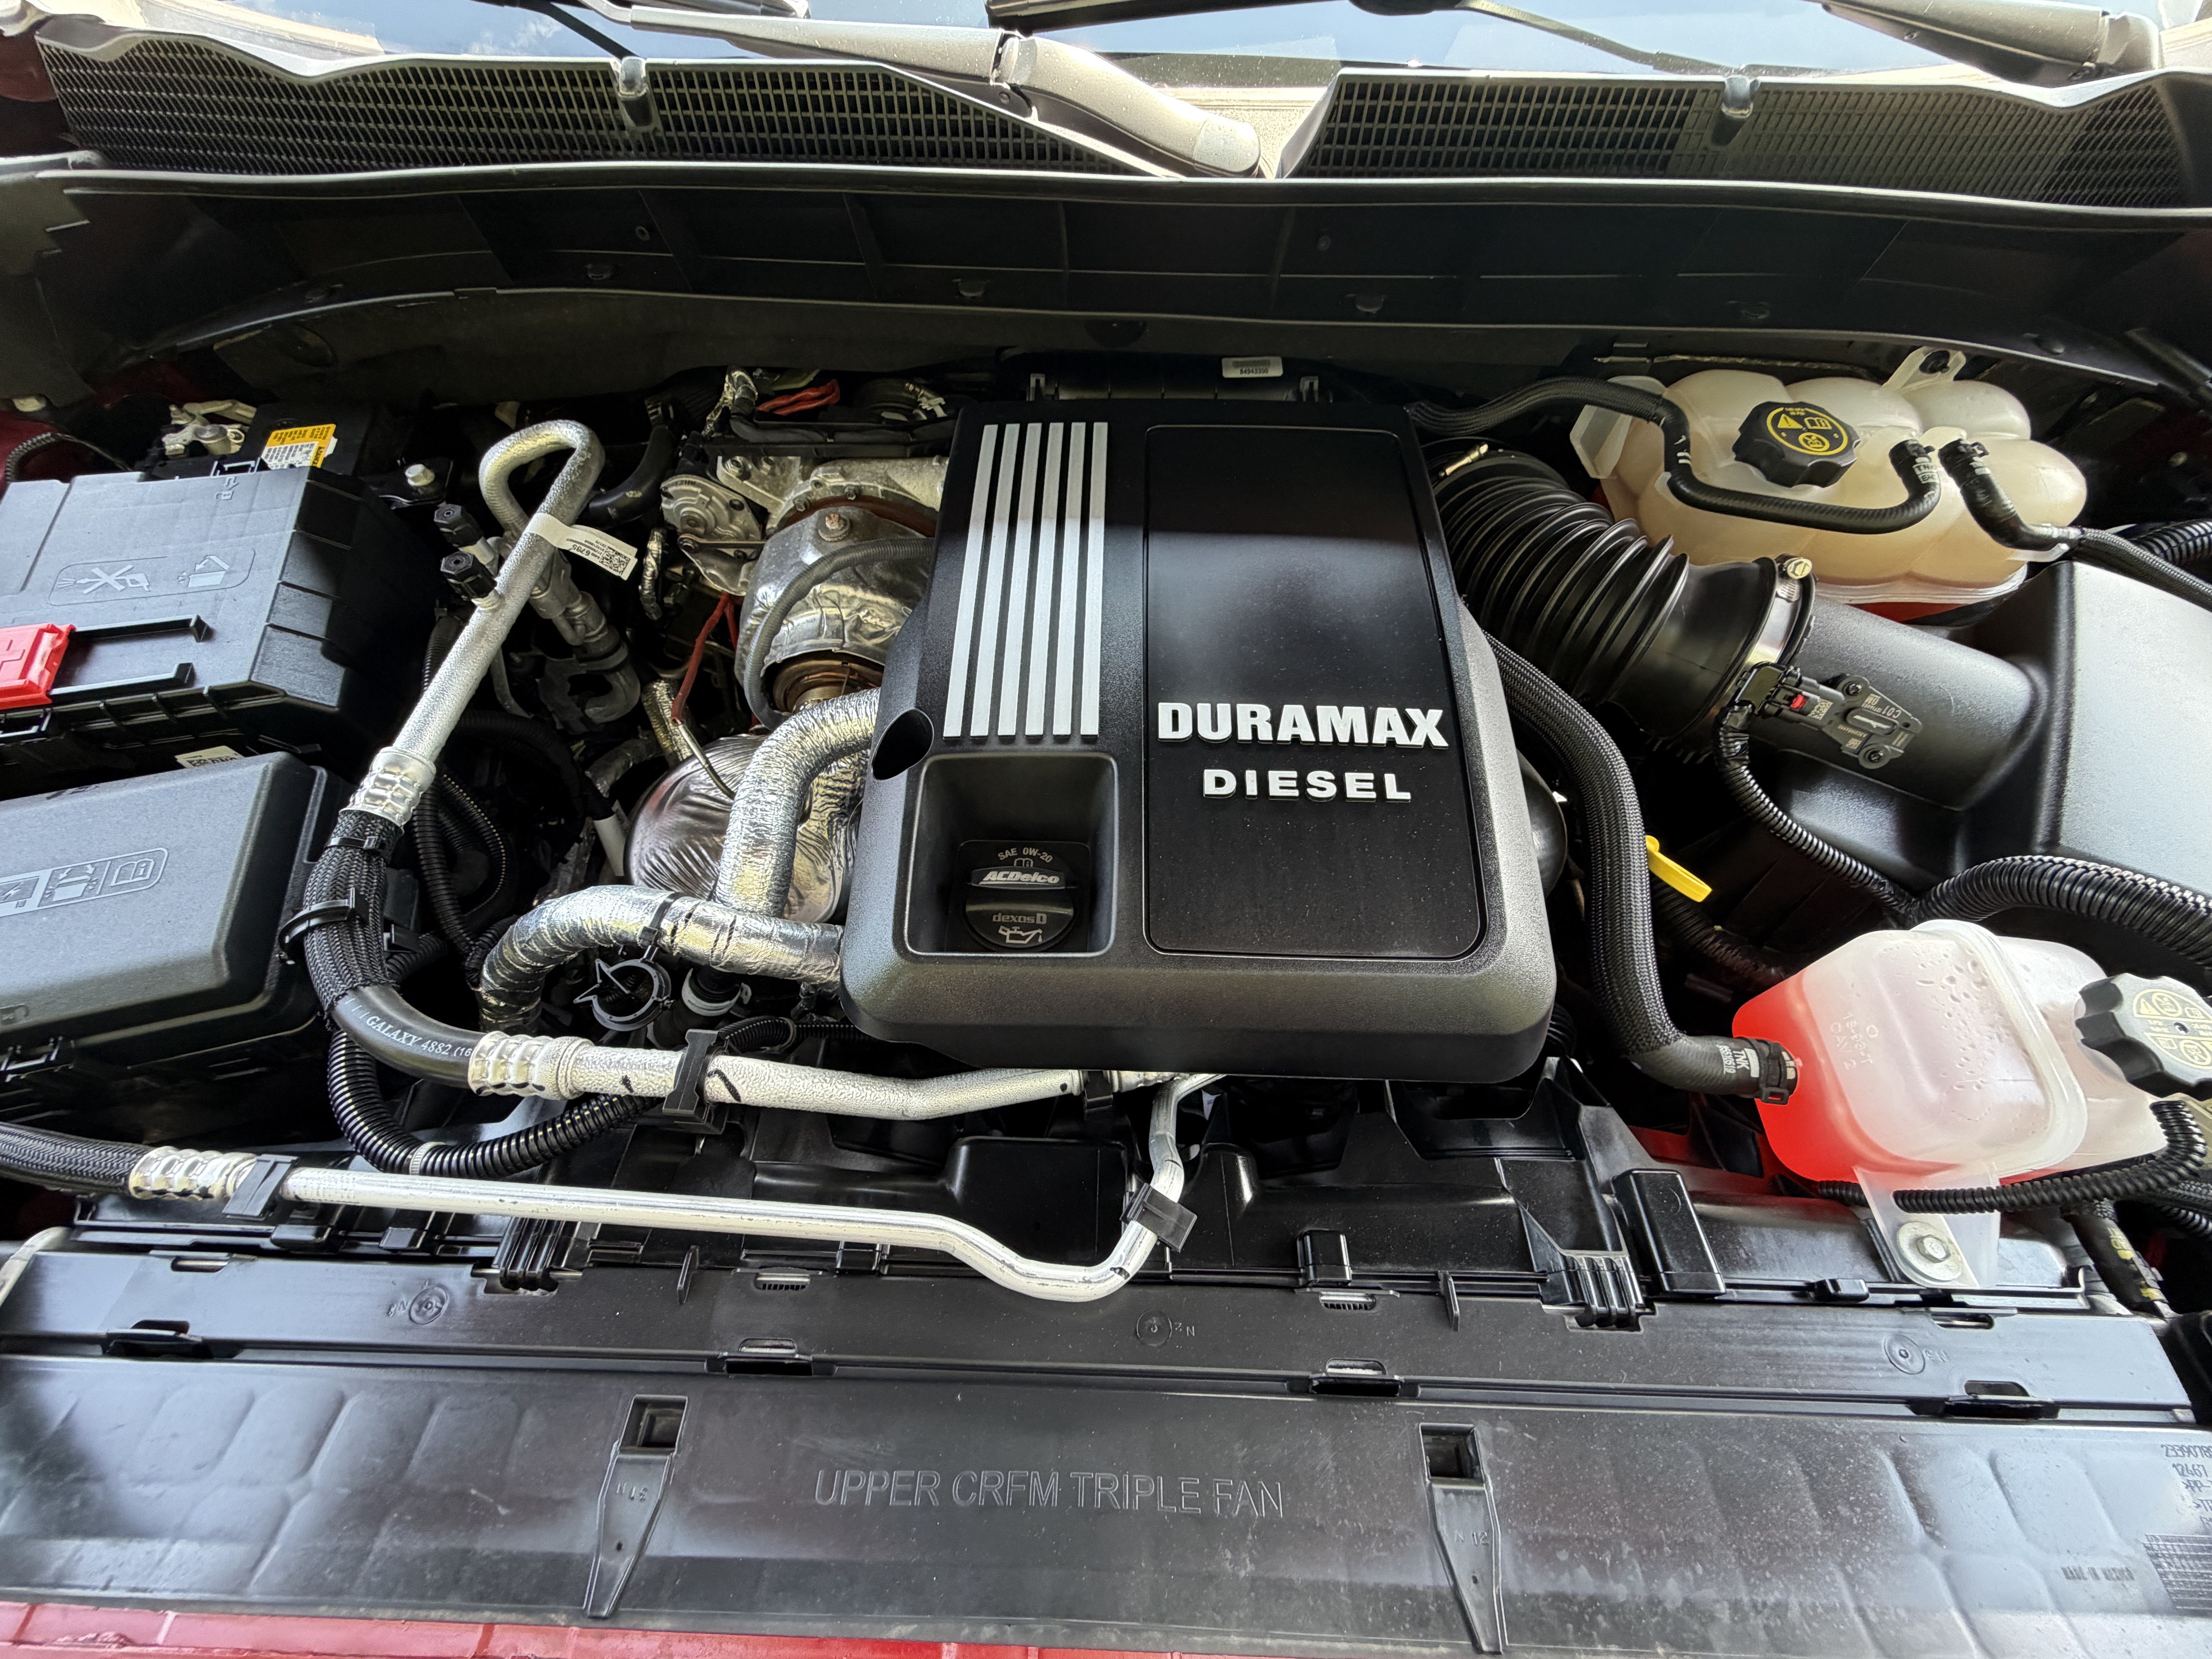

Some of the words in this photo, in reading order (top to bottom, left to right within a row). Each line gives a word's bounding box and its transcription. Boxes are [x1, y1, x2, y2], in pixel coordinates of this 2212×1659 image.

[1157, 702, 1449, 750] DURAMAX
[1203, 769, 1411, 804] DIESEL
[998, 847, 1018, 860] SAE
[1022, 847, 1053, 863] 0W-20
[982, 871, 1060, 884] ACDelco
[366, 1015, 422, 1046] GALAXY
[421, 1040, 452, 1055] 4882
[1733, 1050, 1750, 1070] TNK
[814, 1469, 940, 1506] UPPER
[951, 1470, 1058, 1507] CRFM
[1070, 1472, 1202, 1514] TRIPLE
[1213, 1478, 1283, 1518] FAN
